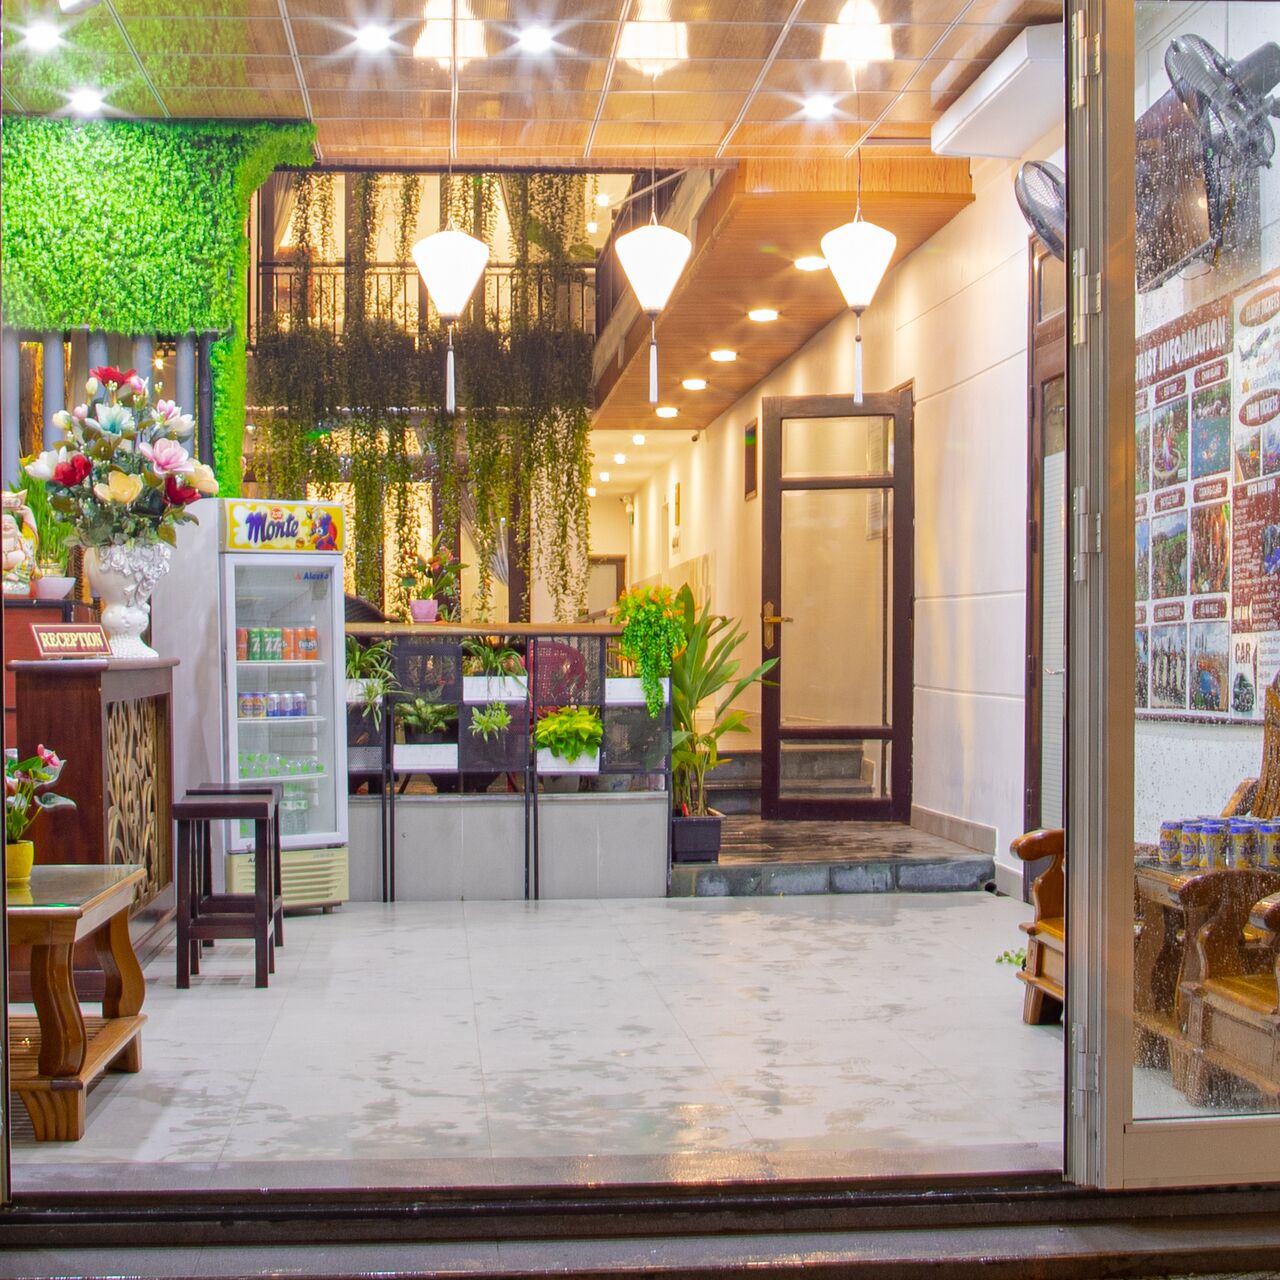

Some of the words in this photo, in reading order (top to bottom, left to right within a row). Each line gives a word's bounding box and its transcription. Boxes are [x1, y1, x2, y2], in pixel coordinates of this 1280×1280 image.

[1158, 315, 1226, 372] INFORMATION
[245, 511, 299, 544] Monte
[39, 632, 104, 648] RECEPTION
[1234, 642, 1251, 664] CAR
